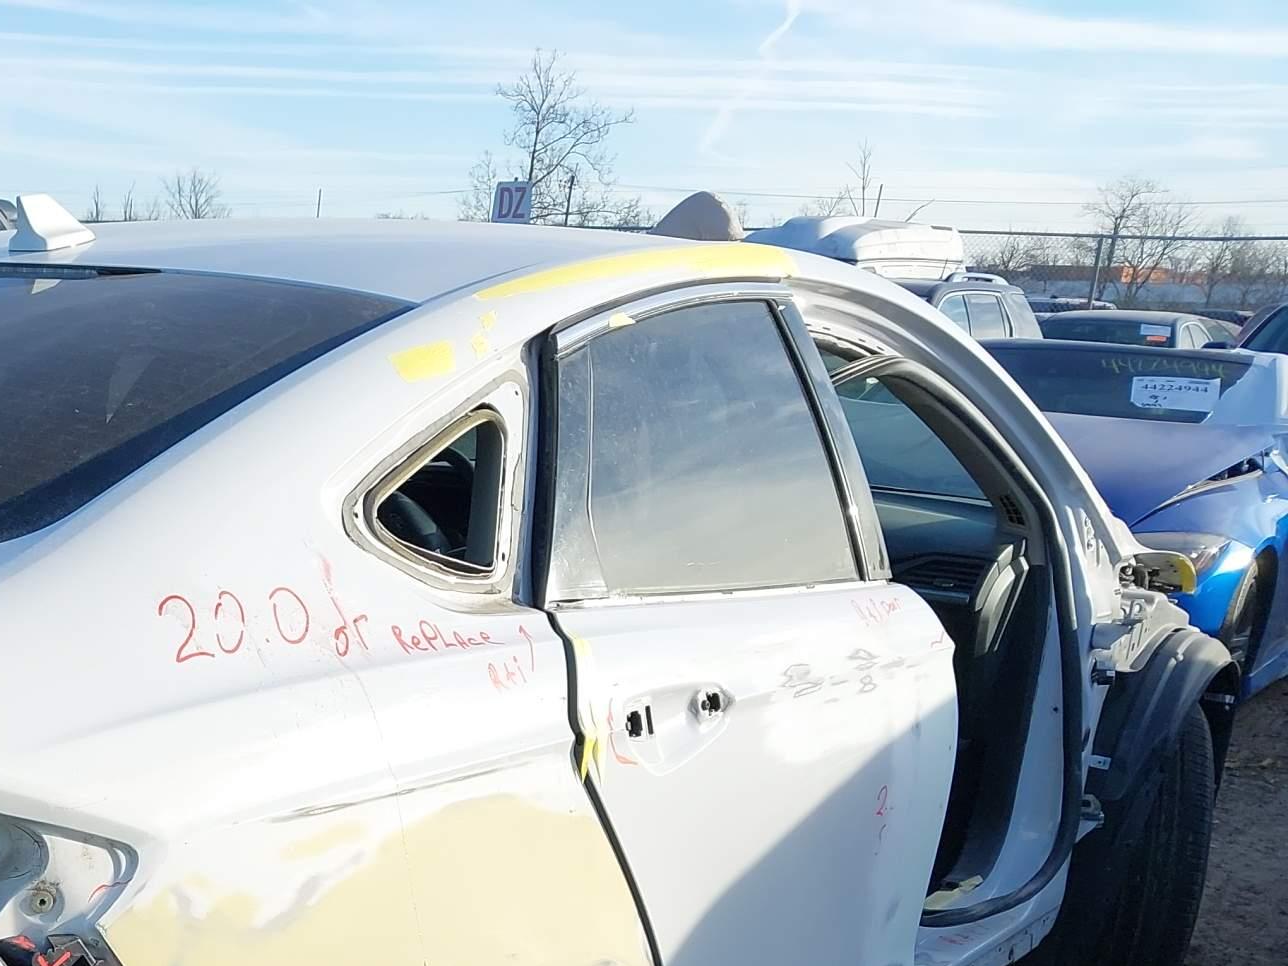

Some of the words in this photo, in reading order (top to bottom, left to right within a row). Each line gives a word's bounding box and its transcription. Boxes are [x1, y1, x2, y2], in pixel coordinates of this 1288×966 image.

[497, 186, 527, 219] DZ
[1141, 383, 1209, 393] 44224944
[158, 586, 310, 663] 20.0
